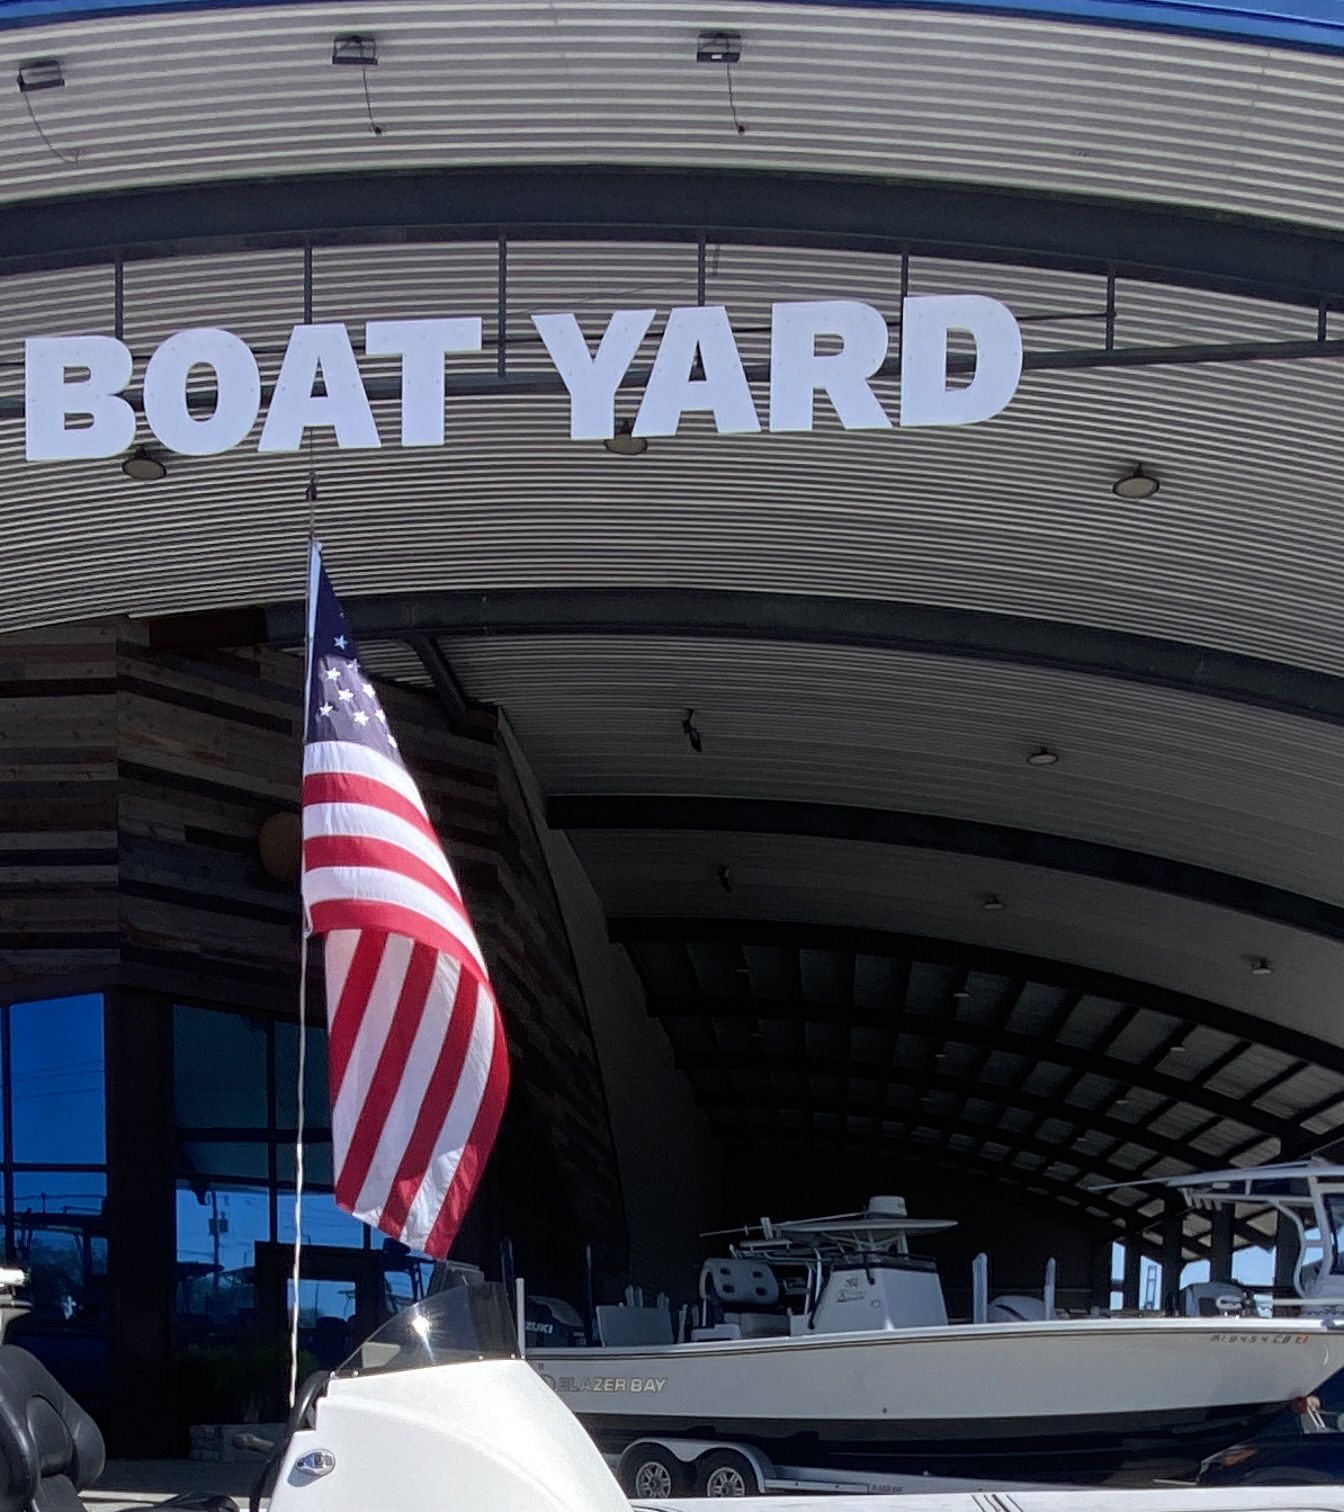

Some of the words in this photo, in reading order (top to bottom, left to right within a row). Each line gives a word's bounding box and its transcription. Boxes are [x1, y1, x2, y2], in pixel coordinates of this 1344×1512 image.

[23, 316, 485, 462] BOAT
[530, 293, 1025, 442] YARD
[525, 1320, 554, 1335] ZUKI
[630, 1377, 667, 1393] BAY
